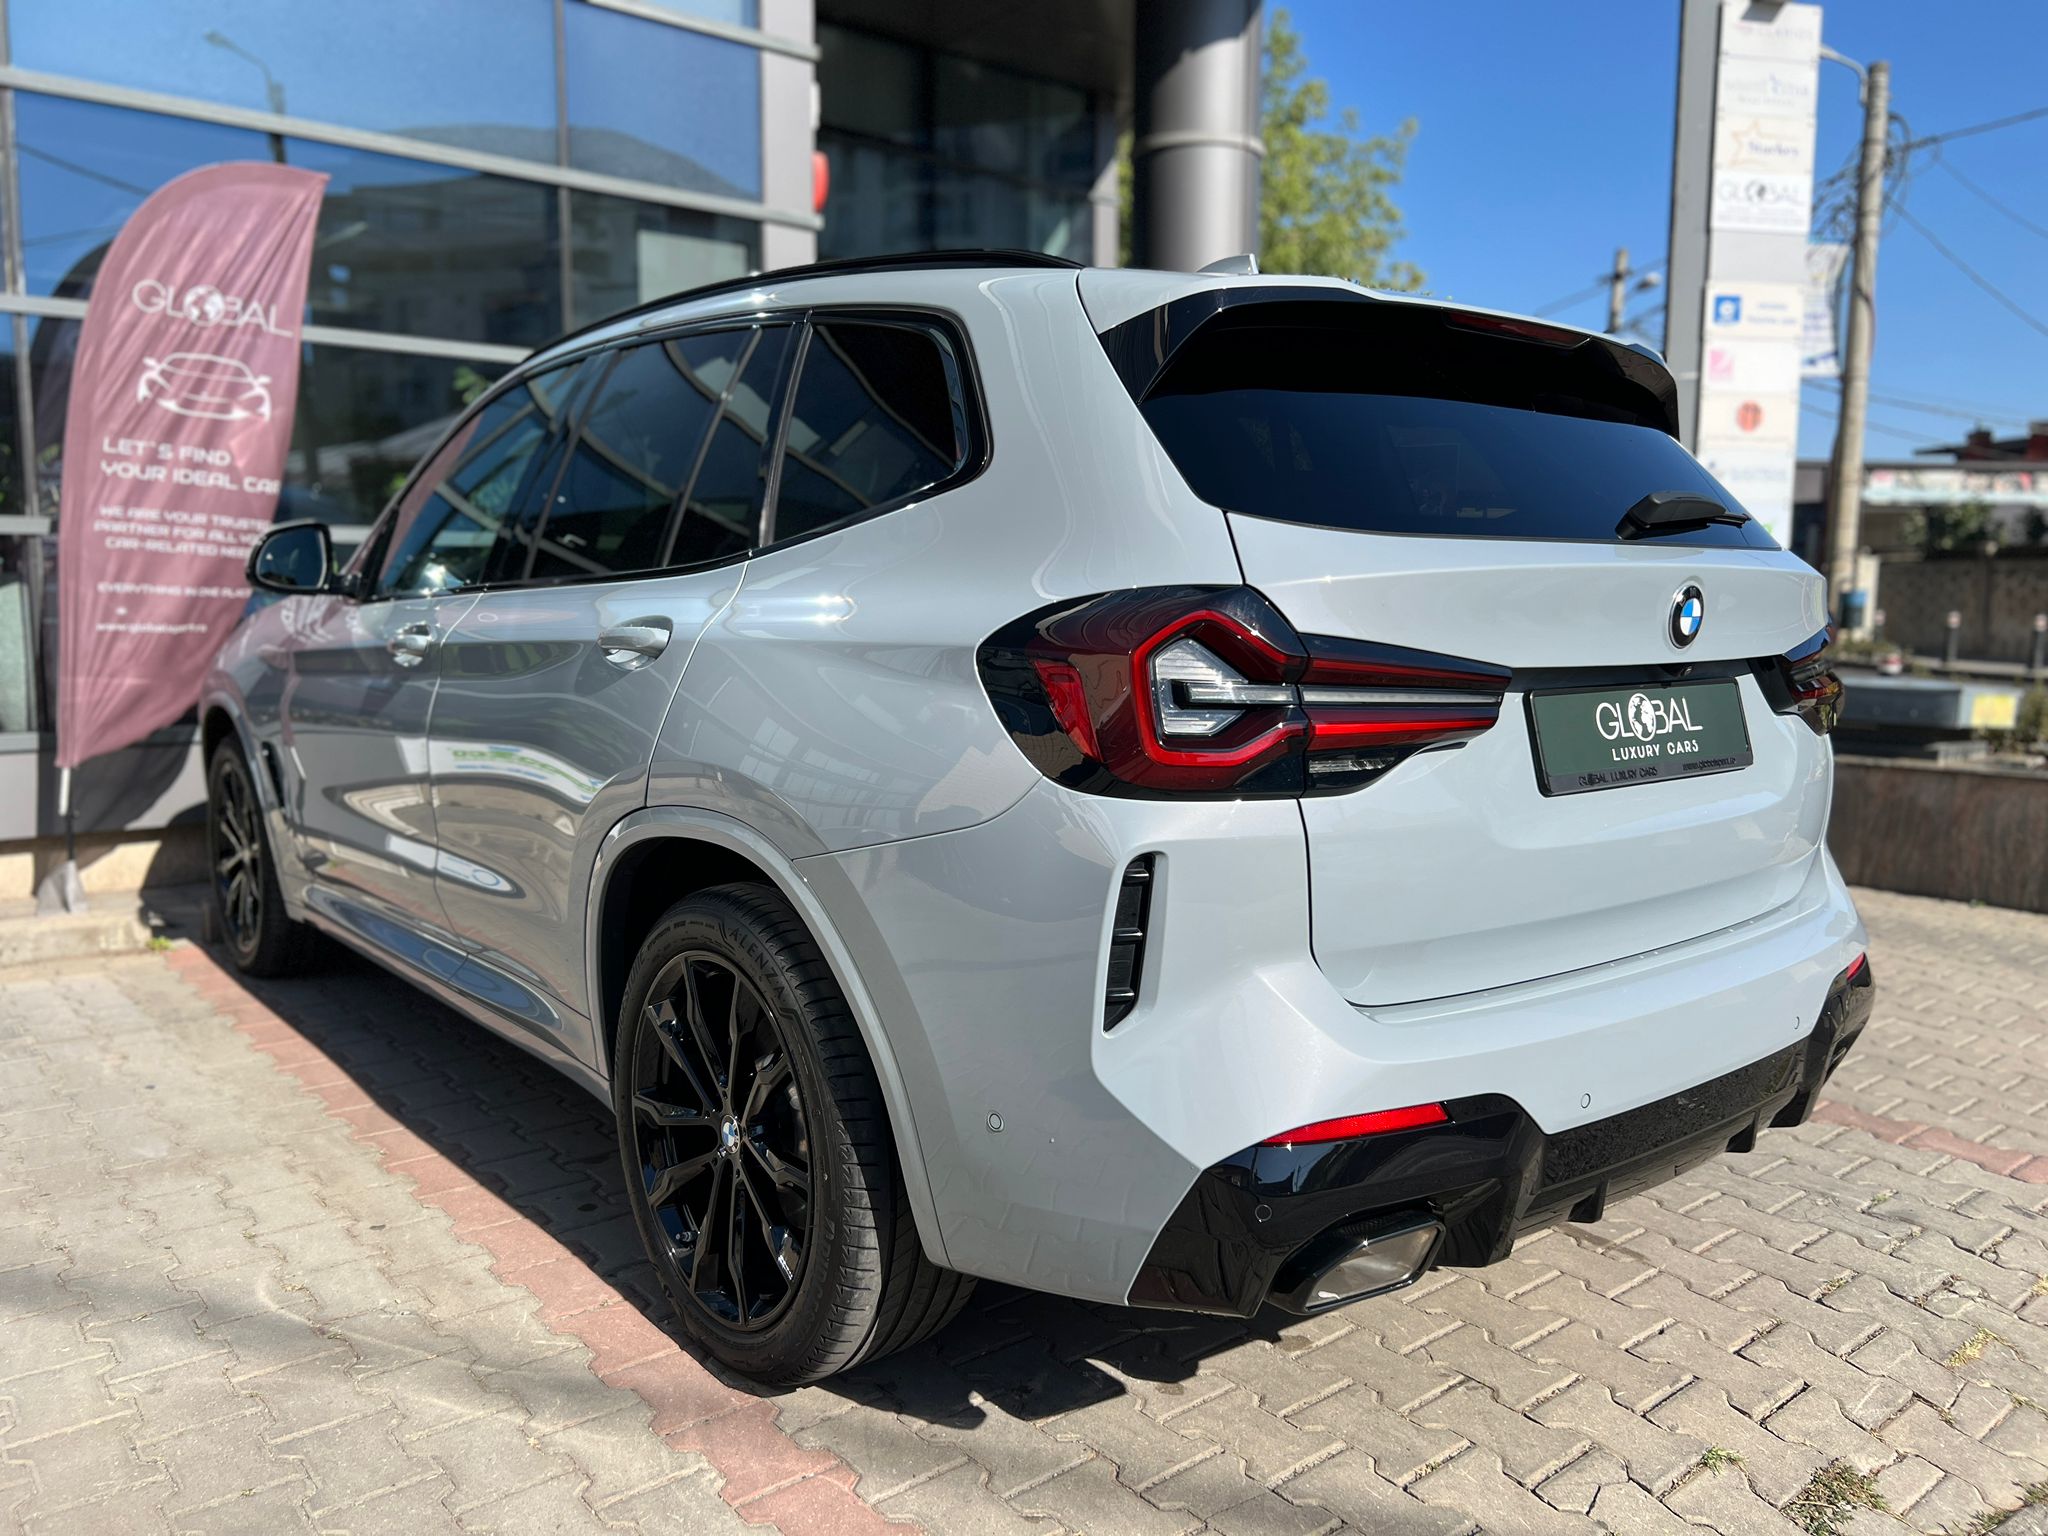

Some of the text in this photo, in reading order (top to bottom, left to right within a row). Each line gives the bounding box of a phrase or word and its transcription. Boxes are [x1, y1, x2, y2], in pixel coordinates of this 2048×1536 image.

[131, 278, 295, 339] GLOBAL
[178, 444, 232, 467] FIND
[100, 459, 167, 483] YOUR
[172, 467, 239, 491] IDEAL
[212, 514, 273, 532] TRUSTE
[1595, 692, 1703, 742] GLOBAL
[1611, 739, 1699, 762] LUXURY CARS
[1578, 766, 1658, 787] GLOBAL LUXURY CARS
[728, 926, 787, 1004] ALENZA
